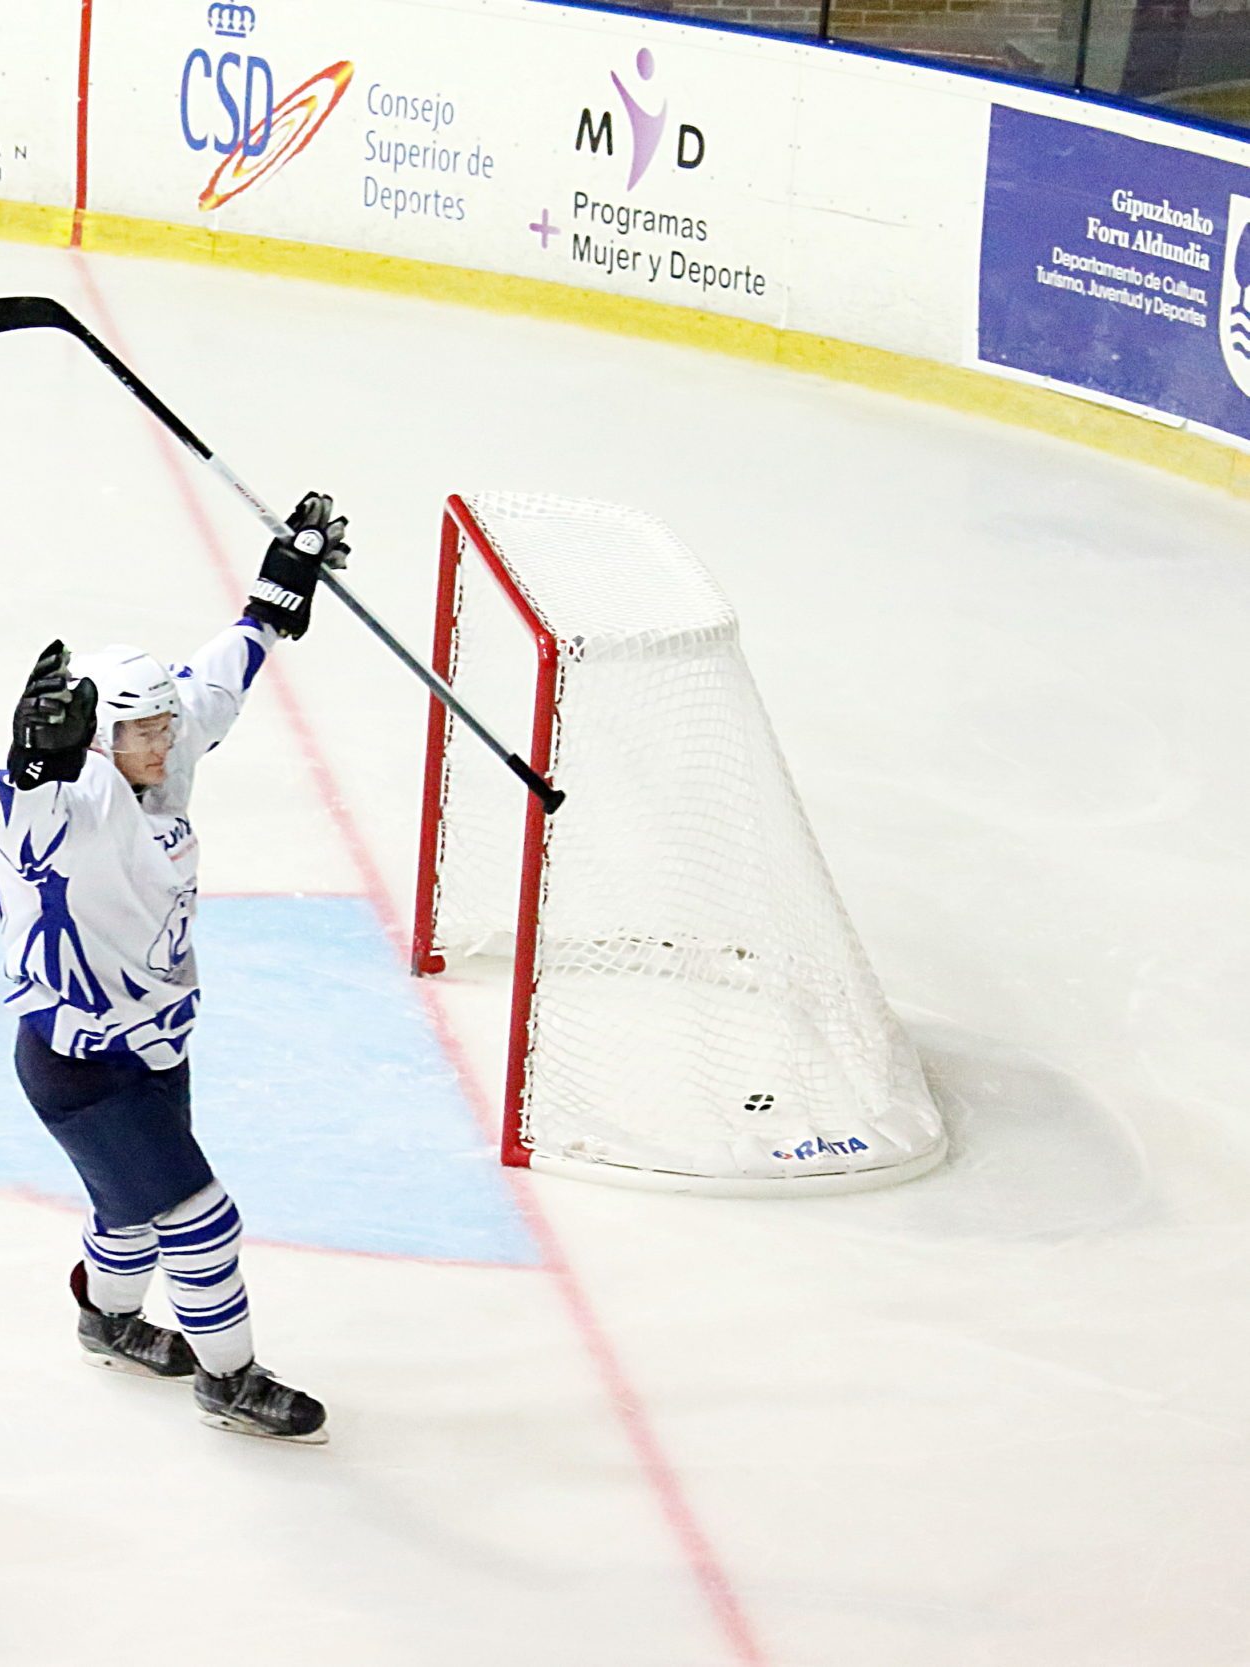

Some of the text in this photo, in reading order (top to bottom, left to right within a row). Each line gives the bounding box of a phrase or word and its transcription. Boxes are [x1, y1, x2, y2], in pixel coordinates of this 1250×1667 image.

[180, 48, 274, 157] CSD
[367, 83, 454, 131] Consejo
[364, 130, 494, 179] Superior de
[364, 176, 465, 221] Deportes
[573, 191, 707, 241] Programas
[1111, 189, 1214, 236] Gipuzkoako
[572, 233, 766, 296] Mujer y Deporte
[1086, 216, 1210, 271] Foru Aldundia
[1052, 247, 1143, 285] Departamento
[1144, 272, 1161, 290] de
[1088, 279, 1143, 309] Juventud
[1145, 297, 1153, 315] y
[1154, 297, 1207, 328] Deportes
